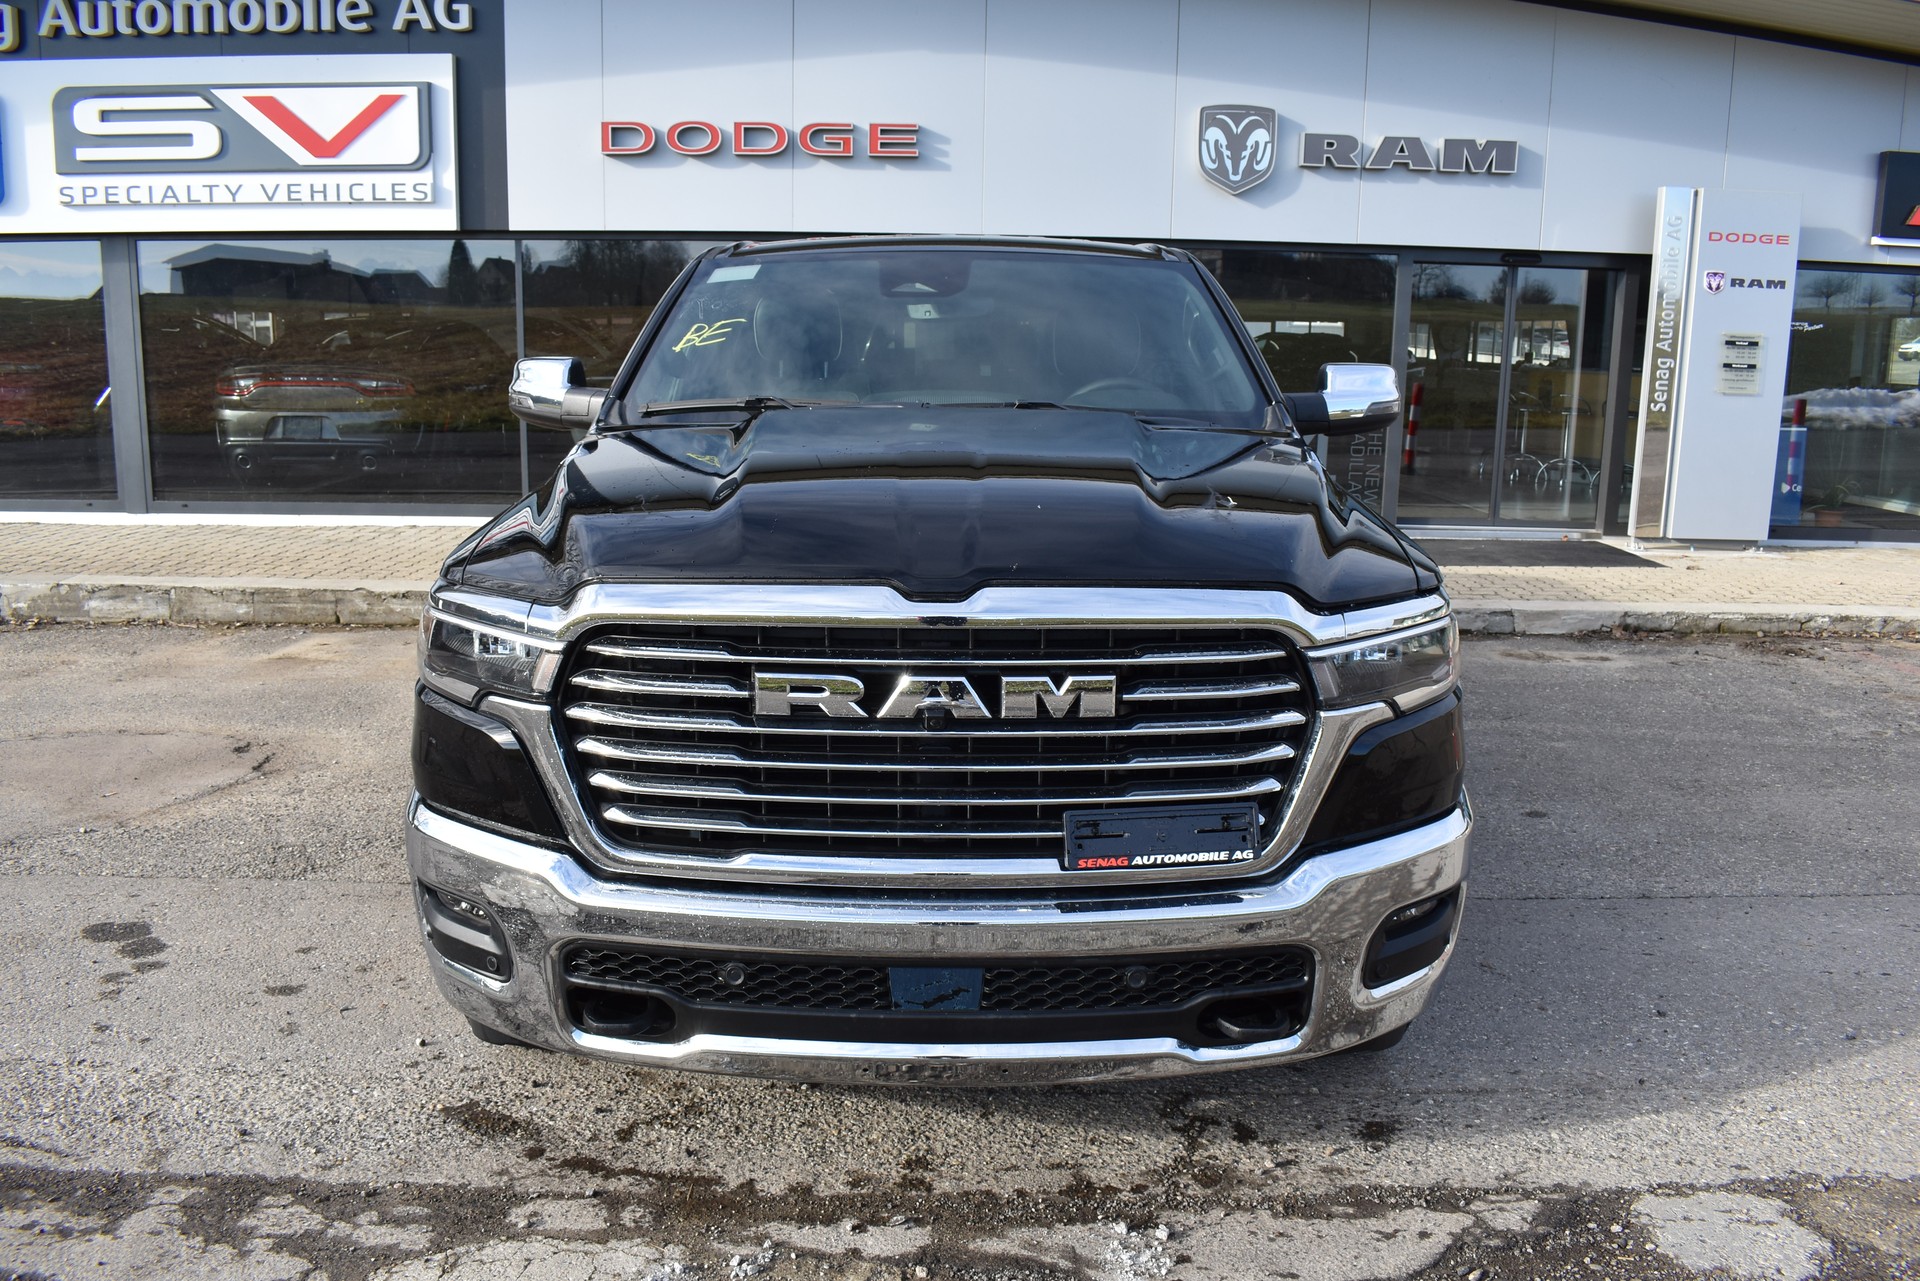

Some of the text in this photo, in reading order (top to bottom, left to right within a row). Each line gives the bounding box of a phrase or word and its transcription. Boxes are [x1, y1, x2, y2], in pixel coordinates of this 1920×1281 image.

[392, 0, 473, 32] AG
[73, 94, 406, 162] SV
[600, 120, 919, 157] DODGE
[1299, 132, 1519, 174] RAM
[59, 183, 428, 204] SPECIALTY VEHICLES
[1708, 231, 1790, 245] DODGE
[1730, 278, 1786, 290] RAM
[1650, 215, 1683, 412] Senag Automobile AG
[1346, 434, 1367, 501] ADILLA
[1363, 427, 1384, 506] HE NEW
[754, 672, 1117, 718] RAM
[1077, 849, 1254, 869] SENAG AUTOMOBILE AG
